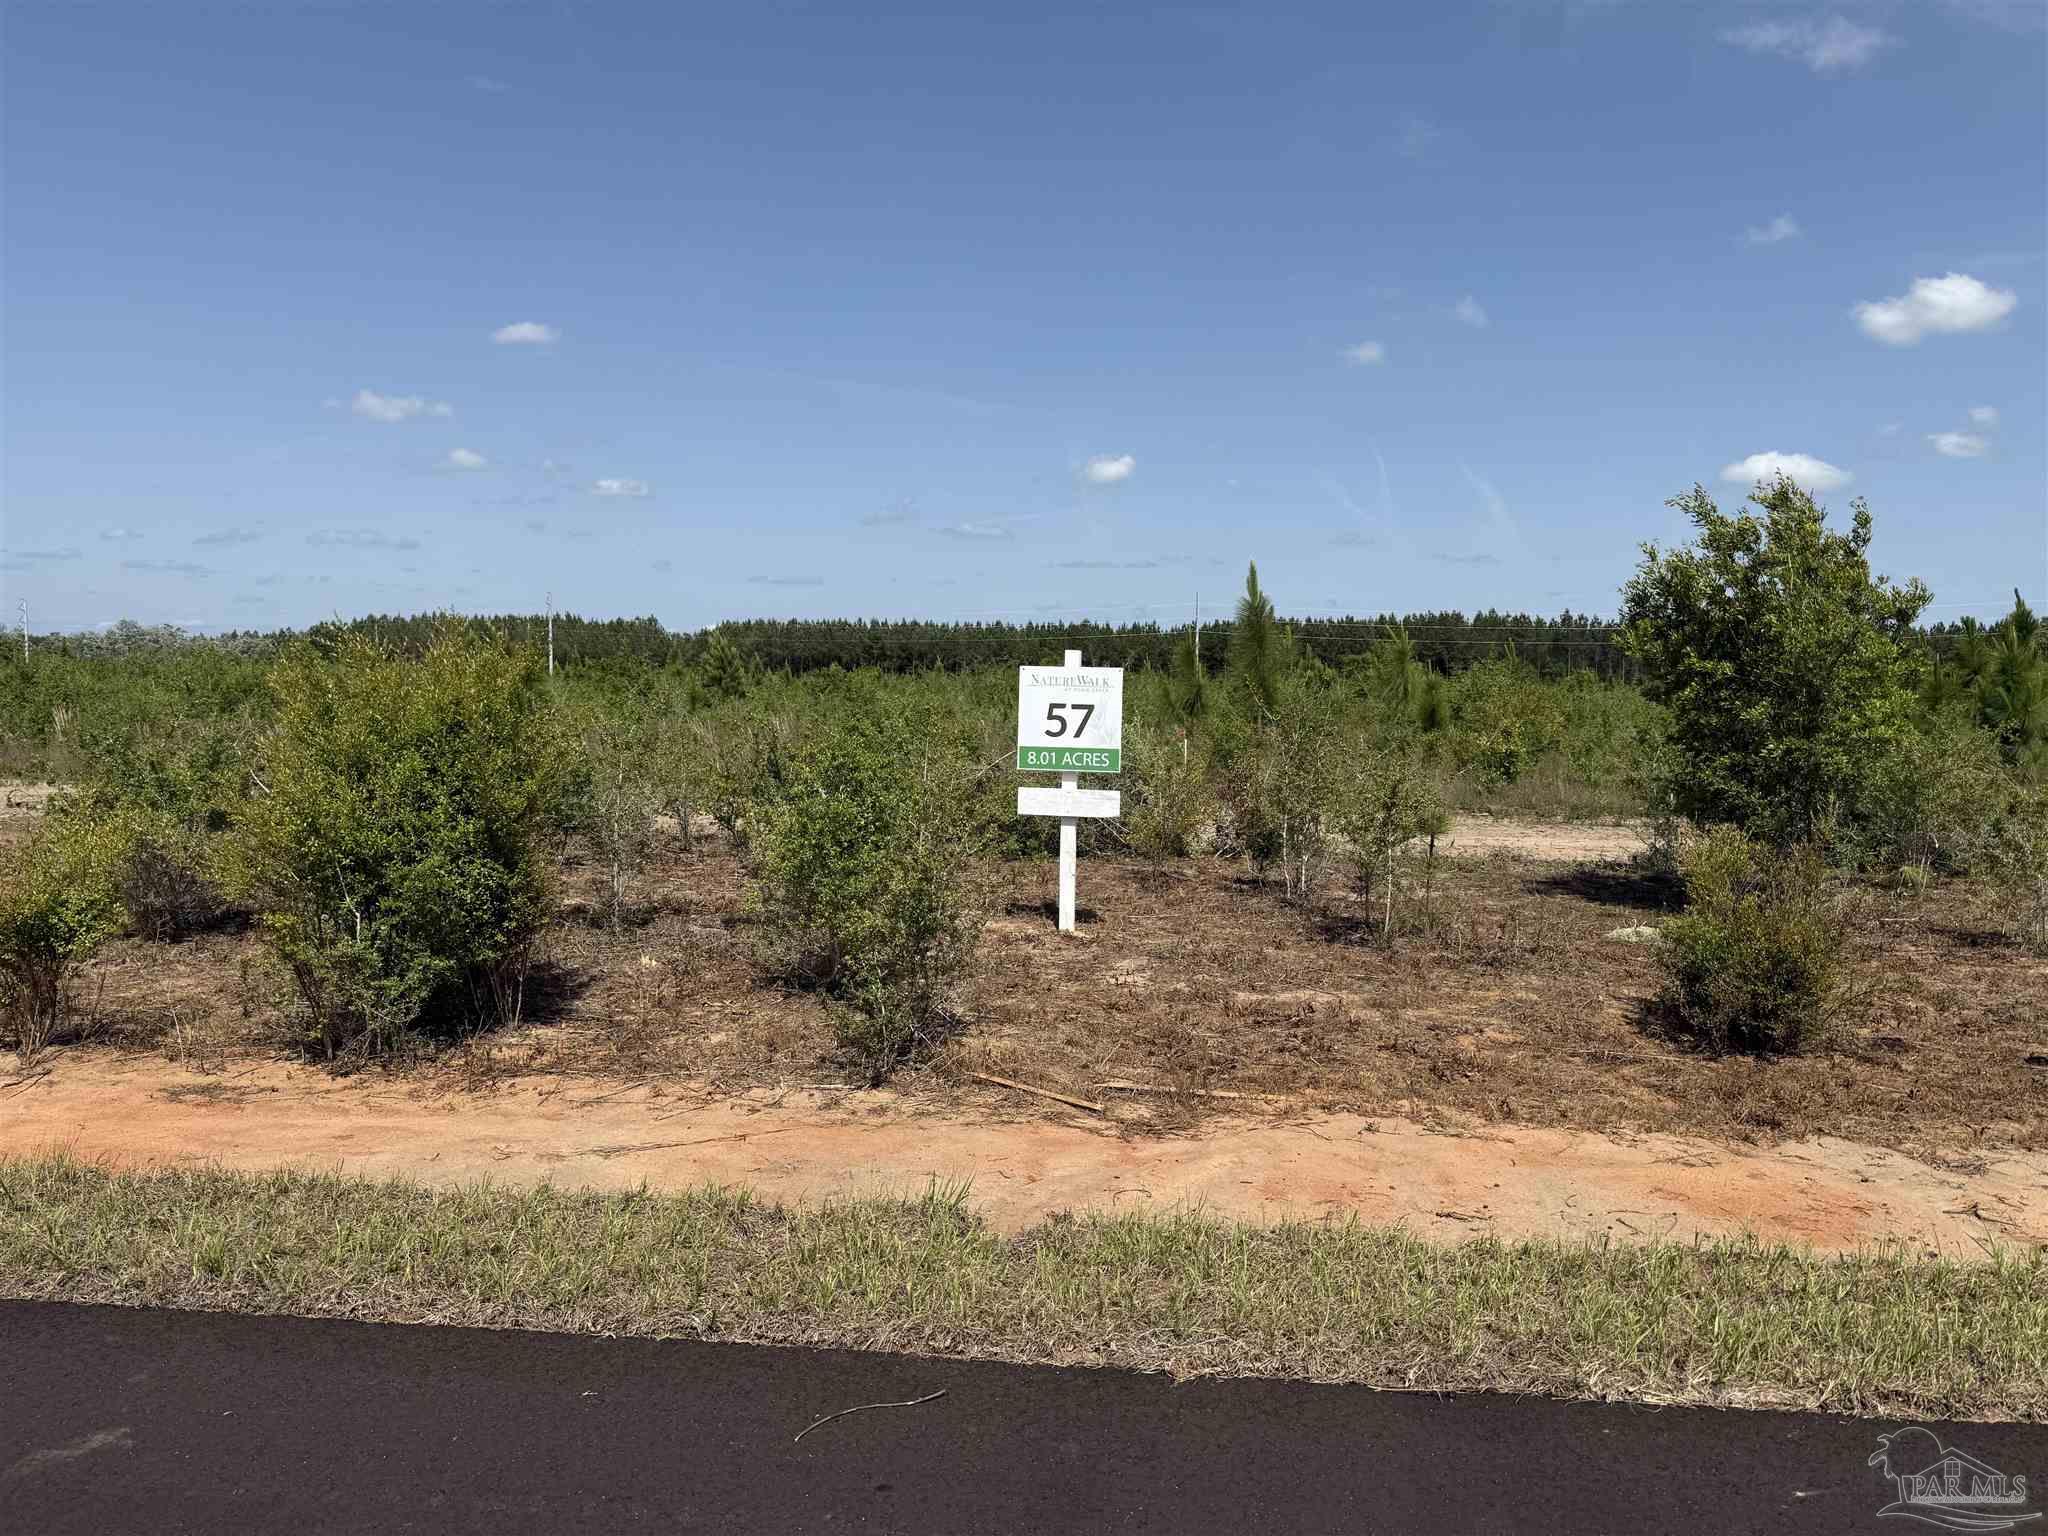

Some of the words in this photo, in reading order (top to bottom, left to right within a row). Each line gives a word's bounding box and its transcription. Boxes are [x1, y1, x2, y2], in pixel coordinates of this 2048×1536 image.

[1044, 702, 1095, 739] 57
[1027, 751, 1056, 765] 8.01
[1061, 752, 1110, 767] ACRES
